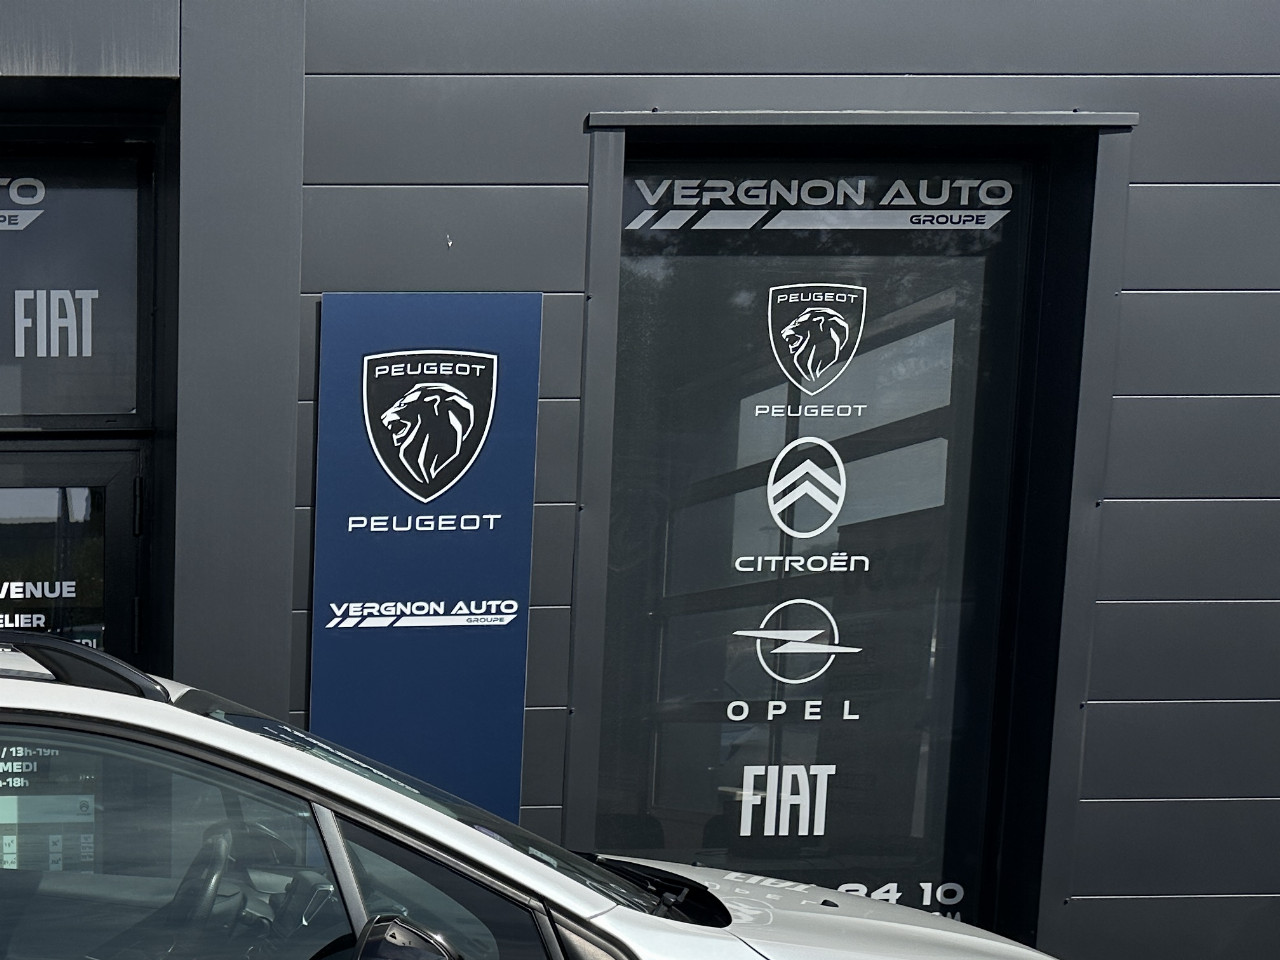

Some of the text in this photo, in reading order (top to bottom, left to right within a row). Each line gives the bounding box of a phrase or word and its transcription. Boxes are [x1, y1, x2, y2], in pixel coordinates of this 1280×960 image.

[635, 178, 1013, 206] VERGNON AUTO
[909, 214, 986, 225] GROUPE
[777, 292, 858, 304] PEUGEOT
[14, 289, 99, 357] FIAT
[374, 362, 486, 378] PEUGEOT
[755, 404, 867, 417] PEUGEOT
[347, 514, 502, 533] PEUGEOT
[734, 552, 870, 572] CITROËN
[329, 600, 519, 617] VERGNON AUTO
[726, 700, 860, 721] OPEL
[739, 764, 836, 836] FIAT
[919, 882, 964, 906] 10
